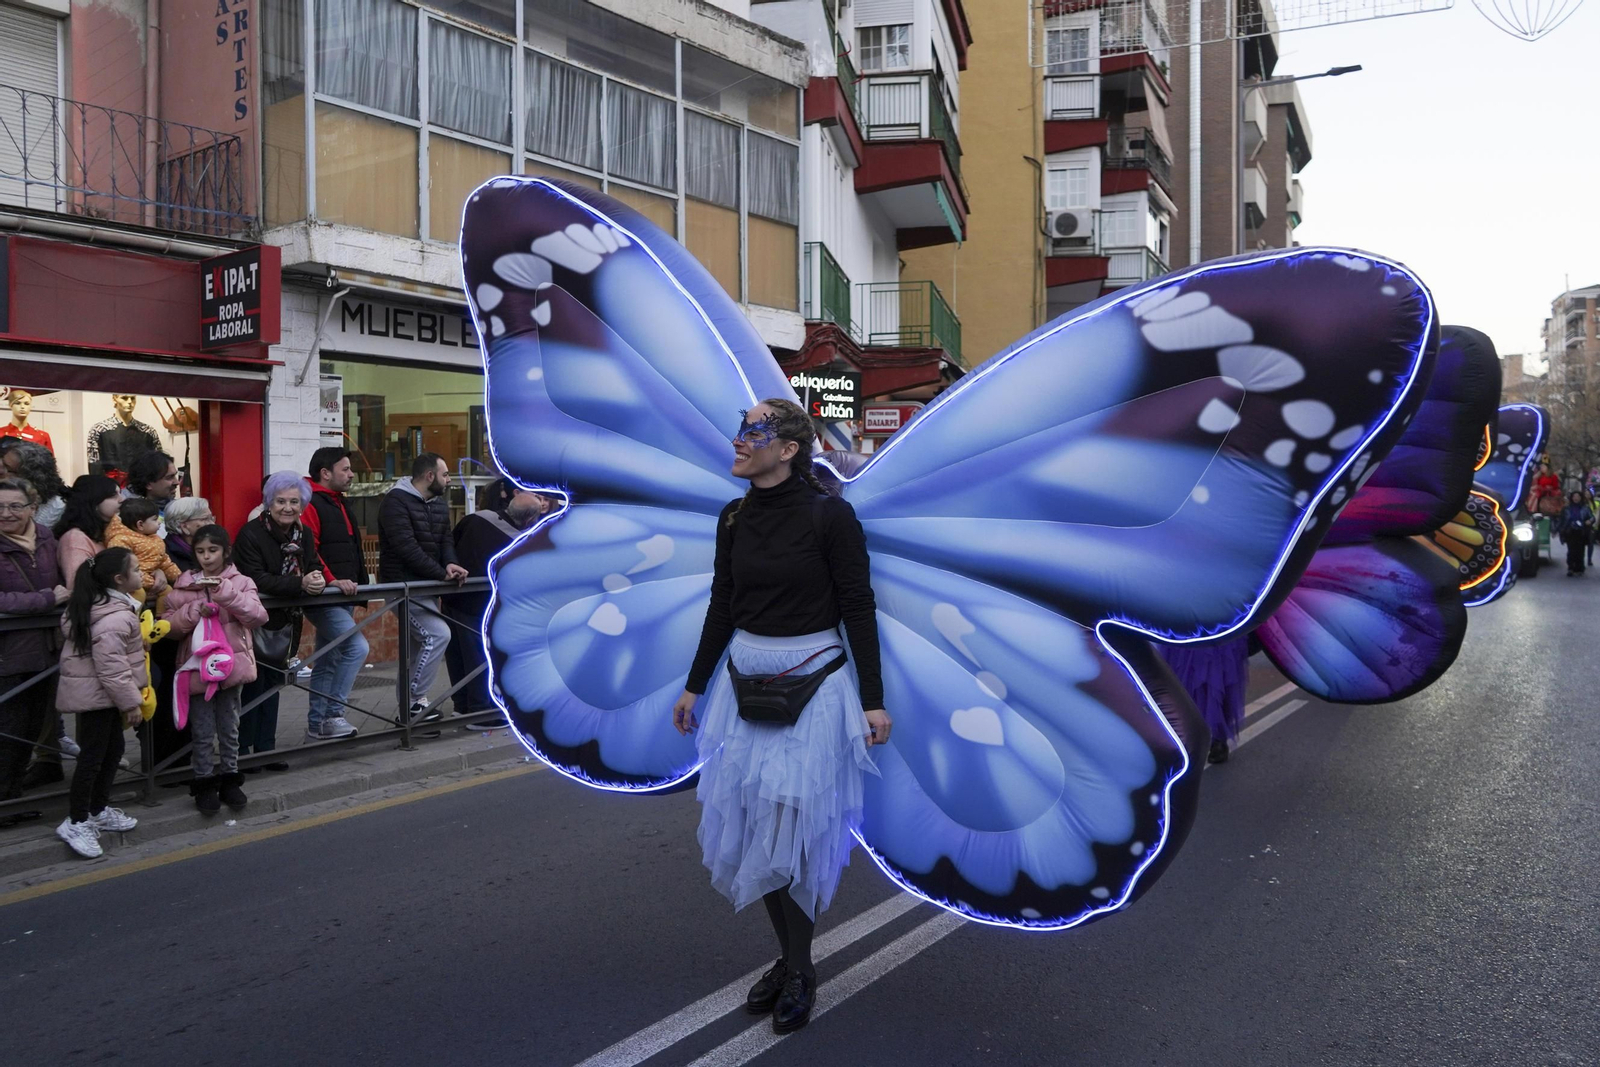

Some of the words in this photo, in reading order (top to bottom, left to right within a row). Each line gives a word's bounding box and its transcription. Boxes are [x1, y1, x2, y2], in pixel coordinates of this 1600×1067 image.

[232, 0, 248, 122] RTES
[205, 262, 258, 300] EKIPA-T
[219, 302, 244, 321] ROPA
[209, 318, 254, 341] LABORAL
[788, 372, 854, 392] eluquería
[812, 402, 853, 418] Sultán
